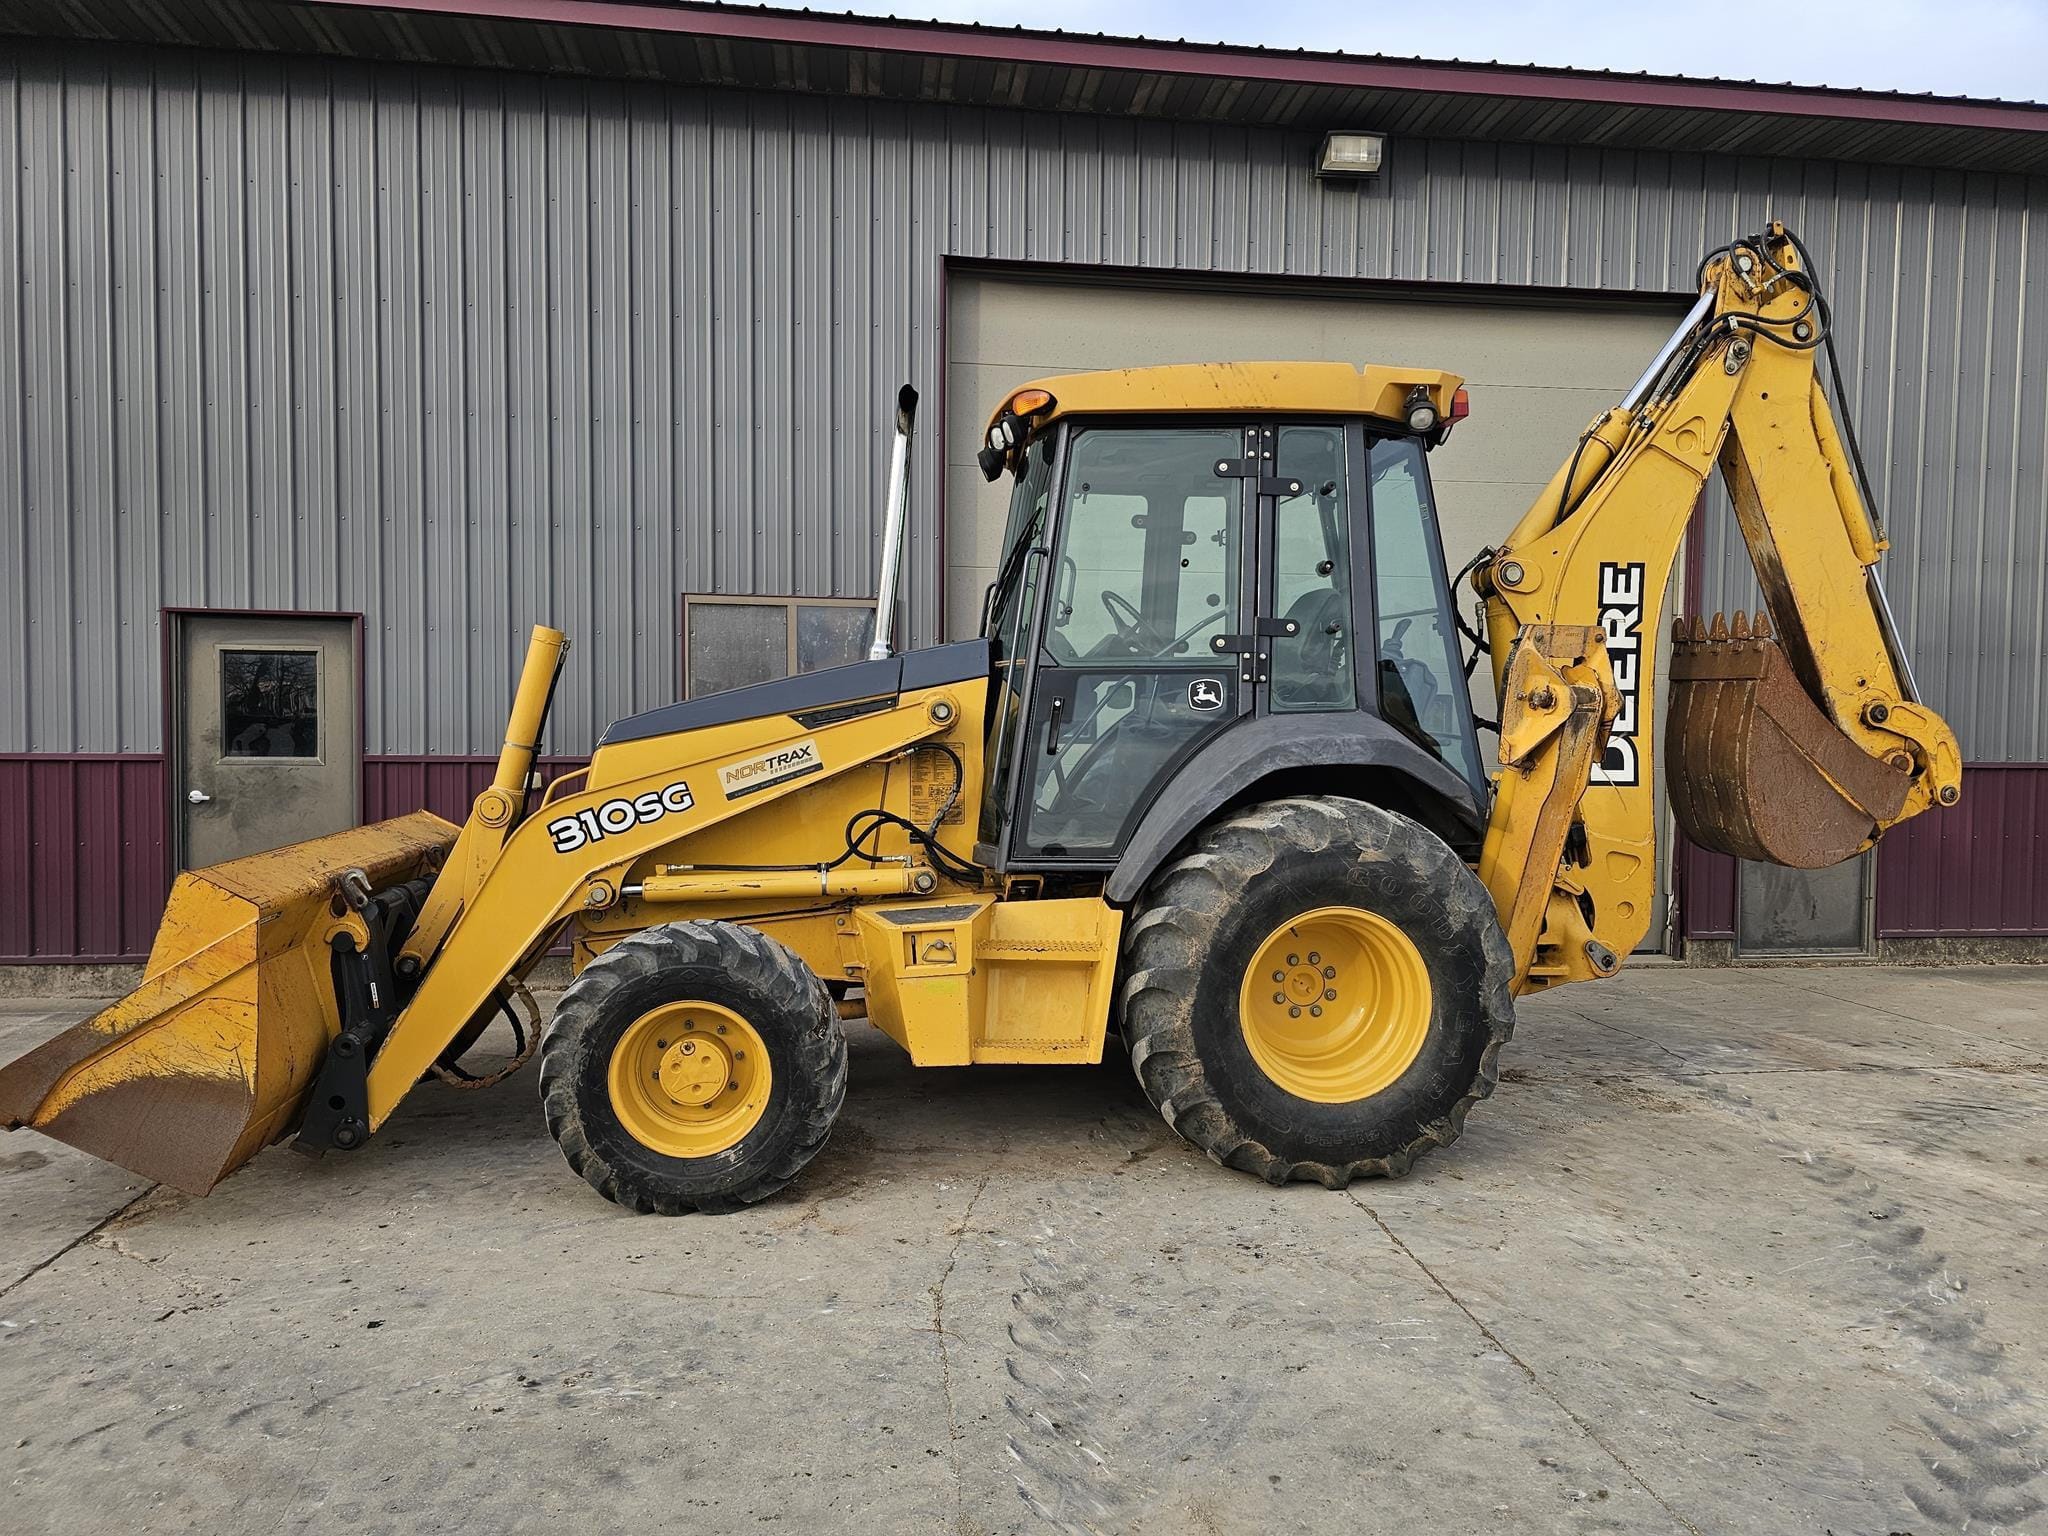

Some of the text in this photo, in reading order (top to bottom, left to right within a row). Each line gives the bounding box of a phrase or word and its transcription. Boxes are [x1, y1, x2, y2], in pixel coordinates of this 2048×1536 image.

[1589, 562, 1645, 786] DEERE
[726, 745, 811, 784] NORTRAX
[547, 781, 695, 853] 310SG
